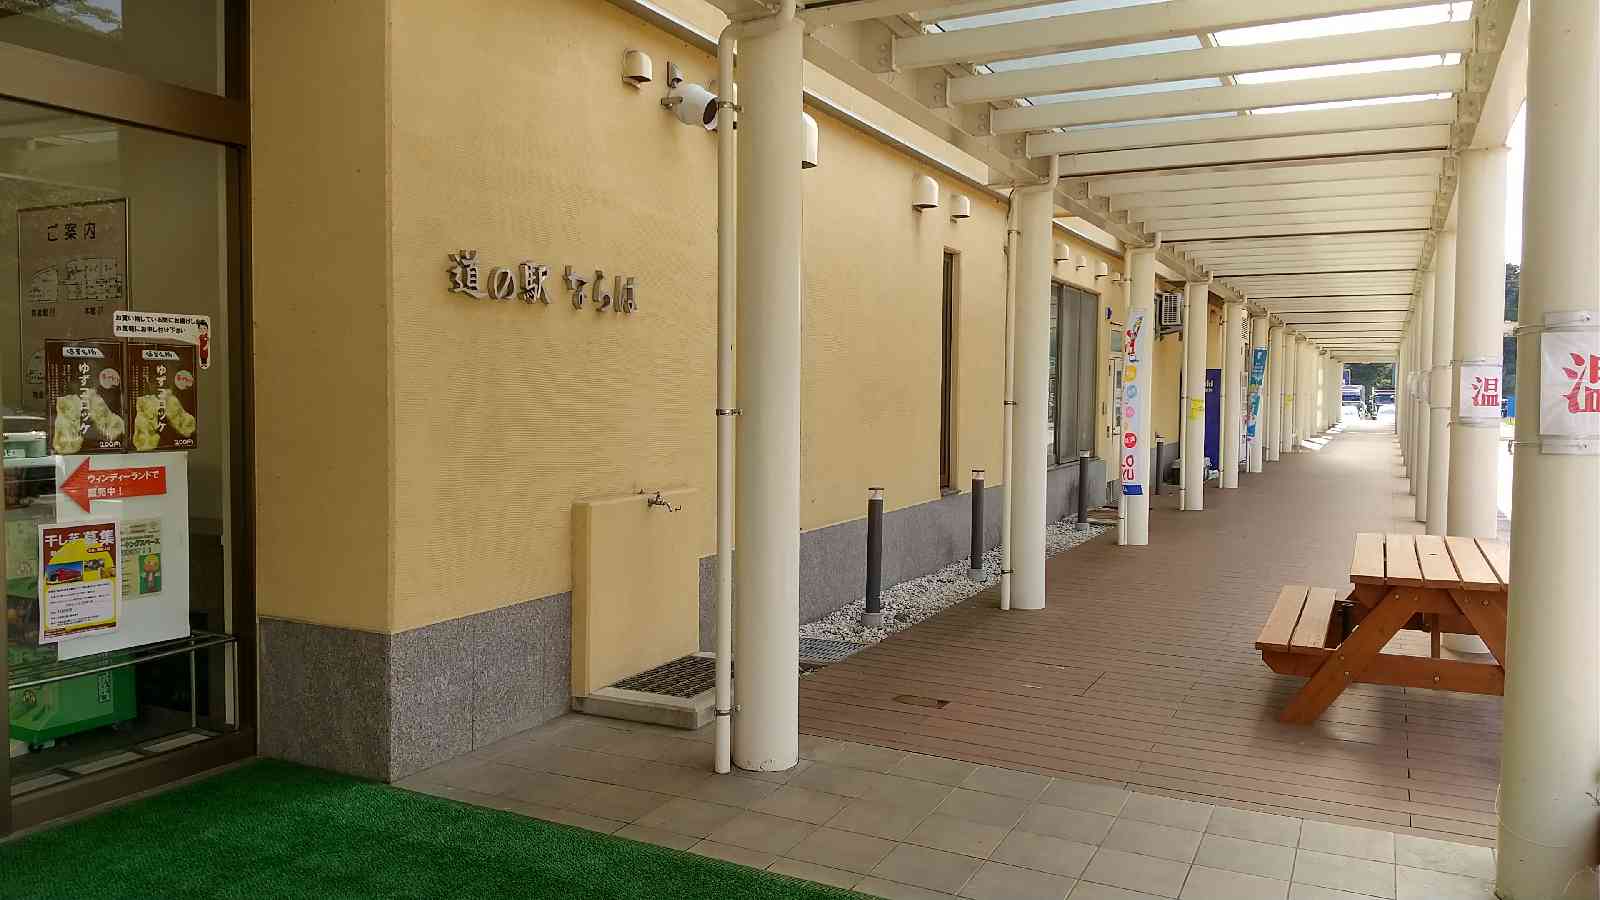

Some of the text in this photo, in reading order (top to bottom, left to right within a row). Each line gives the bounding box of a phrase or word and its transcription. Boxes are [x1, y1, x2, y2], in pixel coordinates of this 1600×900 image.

[446, 249, 640, 314] 道の駅 ならは
[87, 470, 160, 484] ウィンディーランドで
